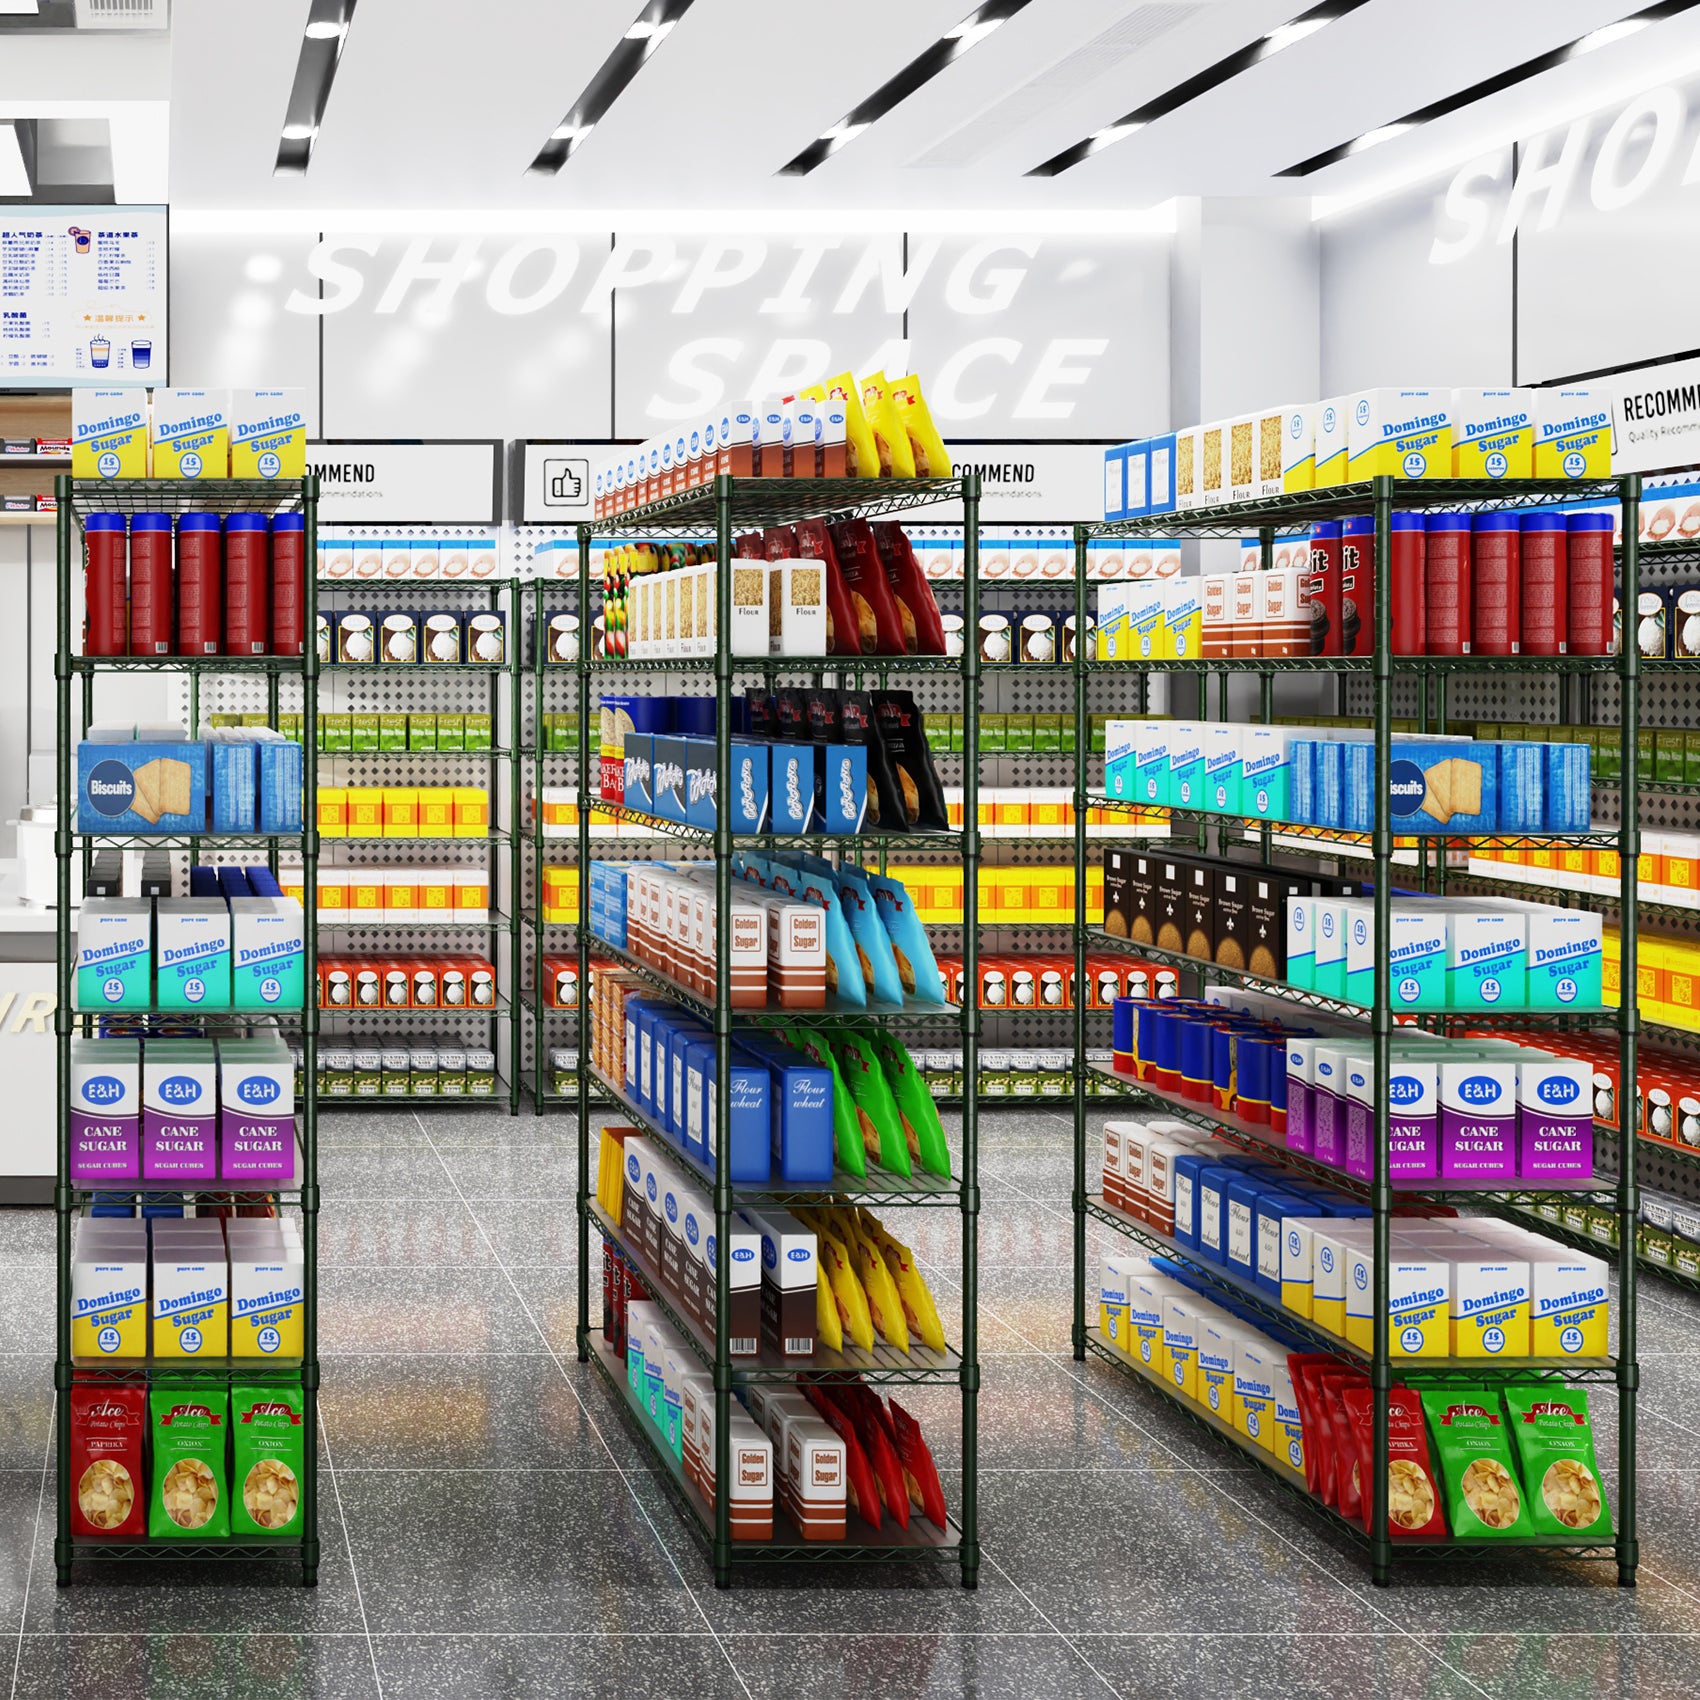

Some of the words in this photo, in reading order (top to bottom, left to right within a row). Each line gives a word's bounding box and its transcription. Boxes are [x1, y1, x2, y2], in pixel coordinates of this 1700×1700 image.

[1428, 86, 1700, 265] SHO
[283, 233, 1045, 316] SHOPPING
[1624, 385, 1700, 421] RECOMM
[77, 412, 141, 436] Domingo
[159, 412, 222, 436] Domingo
[237, 412, 301, 436] Domingo
[1382, 412, 1447, 437] Domingo
[1465, 412, 1528, 436] Domingo
[1542, 412, 1607, 436] Domingo
[90, 433, 132, 452] Sugar
[172, 433, 214, 452] Sugar
[250, 433, 292, 452] Sugar
[1396, 433, 1438, 452] Sugar
[1478, 433, 1520, 452] Sugar
[1556, 433, 1598, 452] Sugar
[103, 458, 114, 467] 15
[184, 458, 196, 467] 15
[263, 458, 275, 467] 15
[1408, 457, 1420, 466] 15
[1490, 457, 1502, 466] 15
[1568, 457, 1580, 466] 15
[1132, 600, 1161, 622] Domingo
[1166, 598, 1196, 620] Domingo
[1138, 619, 1157, 636] Sugar
[1172, 618, 1192, 634] Sugar
[1246, 752, 1280, 772] Domingo
[91, 780, 133, 796] Biscuits
[1252, 773, 1276, 788] Sugar
[735, 918, 758, 930] Golden
[794, 918, 816, 930] Golden
[82, 938, 144, 962] Domingo
[164, 938, 225, 962] Domingo
[240, 938, 302, 962] Domingo
[735, 936, 758, 948] Sugar
[794, 936, 816, 948] Sugar
[1460, 938, 1520, 962] Domingo
[1536, 938, 1598, 962] Domingo
[96, 958, 136, 978] Sugar
[176, 958, 218, 978] Sugar
[252, 958, 294, 978] Sugar
[1392, 958, 1433, 978] Sugar
[1472, 958, 1512, 978] Sugar
[1548, 958, 1590, 978] Sugar
[108, 982, 120, 991] 15
[188, 982, 200, 991] 15
[264, 982, 276, 991] 15
[1403, 982, 1414, 991] 15
[1484, 982, 1496, 991] 15
[1560, 982, 1572, 991] 15
[88, 1084, 120, 1098] E&H
[165, 1084, 196, 1098] E&H
[244, 1084, 274, 1098] E&H
[730, 1078, 762, 1094] Flour
[793, 1078, 826, 1094] Flour
[1464, 1084, 1497, 1098] E&H
[1544, 1084, 1574, 1098] E&H
[730, 1098, 762, 1109] wheat
[794, 1098, 825, 1109] wheat
[84, 1126, 122, 1137] CANE
[160, 1126, 199, 1137] CANE
[239, 1126, 278, 1137] CANE
[1390, 1126, 1420, 1137] ANE
[1460, 1126, 1499, 1137] CANE
[1538, 1126, 1577, 1137] CANE
[79, 1141, 127, 1152] SUGAR
[156, 1141, 204, 1152] SUGAR
[234, 1141, 282, 1152] SUGAR
[1454, 1141, 1504, 1152] SUGAR
[1534, 1141, 1582, 1152] SUGAR
[78, 1287, 141, 1311] Domingo
[159, 1287, 222, 1311] Domingo
[237, 1287, 301, 1311] Domingo
[1462, 1286, 1525, 1312] Domingo
[1540, 1286, 1604, 1312] Domingo
[90, 1308, 132, 1328] Sugar
[172, 1308, 214, 1328] Sugar
[250, 1308, 292, 1328] Sugar
[1393, 1308, 1436, 1328] Sugar
[1476, 1308, 1517, 1328] Sugar
[1553, 1308, 1596, 1328] Sugar
[184, 1332, 196, 1341] 15
[1487, 1332, 1500, 1342] 15
[1236, 1378, 1271, 1394] Domingo
[90, 1399, 124, 1418] Ace
[173, 1400, 207, 1418] Ace
[254, 1398, 288, 1416] Ace
[1243, 1398, 1266, 1412] Sugar
[1451, 1400, 1484, 1418] Ace
[1536, 1398, 1568, 1417] Ace
[742, 1454, 764, 1464] Golden
[815, 1454, 838, 1464] Golden
[742, 1470, 764, 1483] Sugar
[815, 1470, 838, 1483] Sugar
